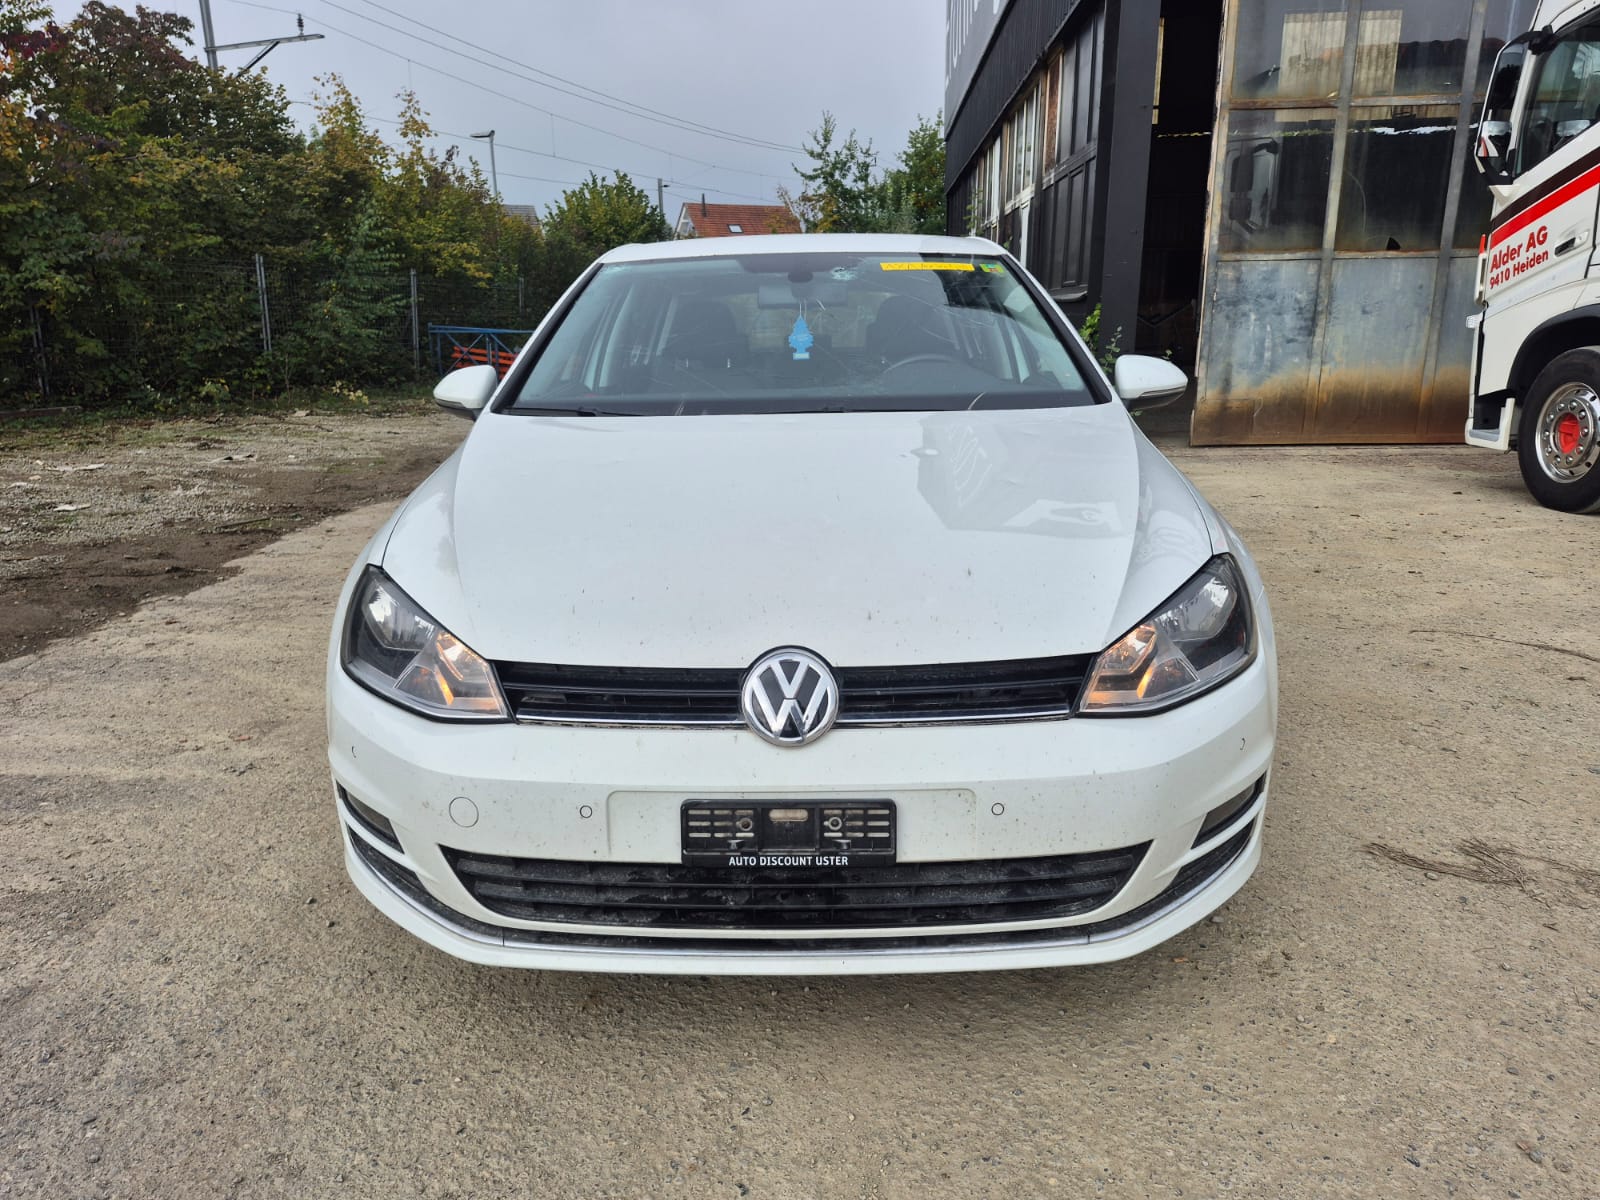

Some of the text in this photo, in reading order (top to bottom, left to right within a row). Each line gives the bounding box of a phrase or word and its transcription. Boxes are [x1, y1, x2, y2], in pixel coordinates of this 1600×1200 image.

[1490, 225, 1548, 273] Alder AG
[1489, 250, 1549, 290] 9410 Heiden
[729, 856, 849, 866] AUTO DISCOUNT USTER
